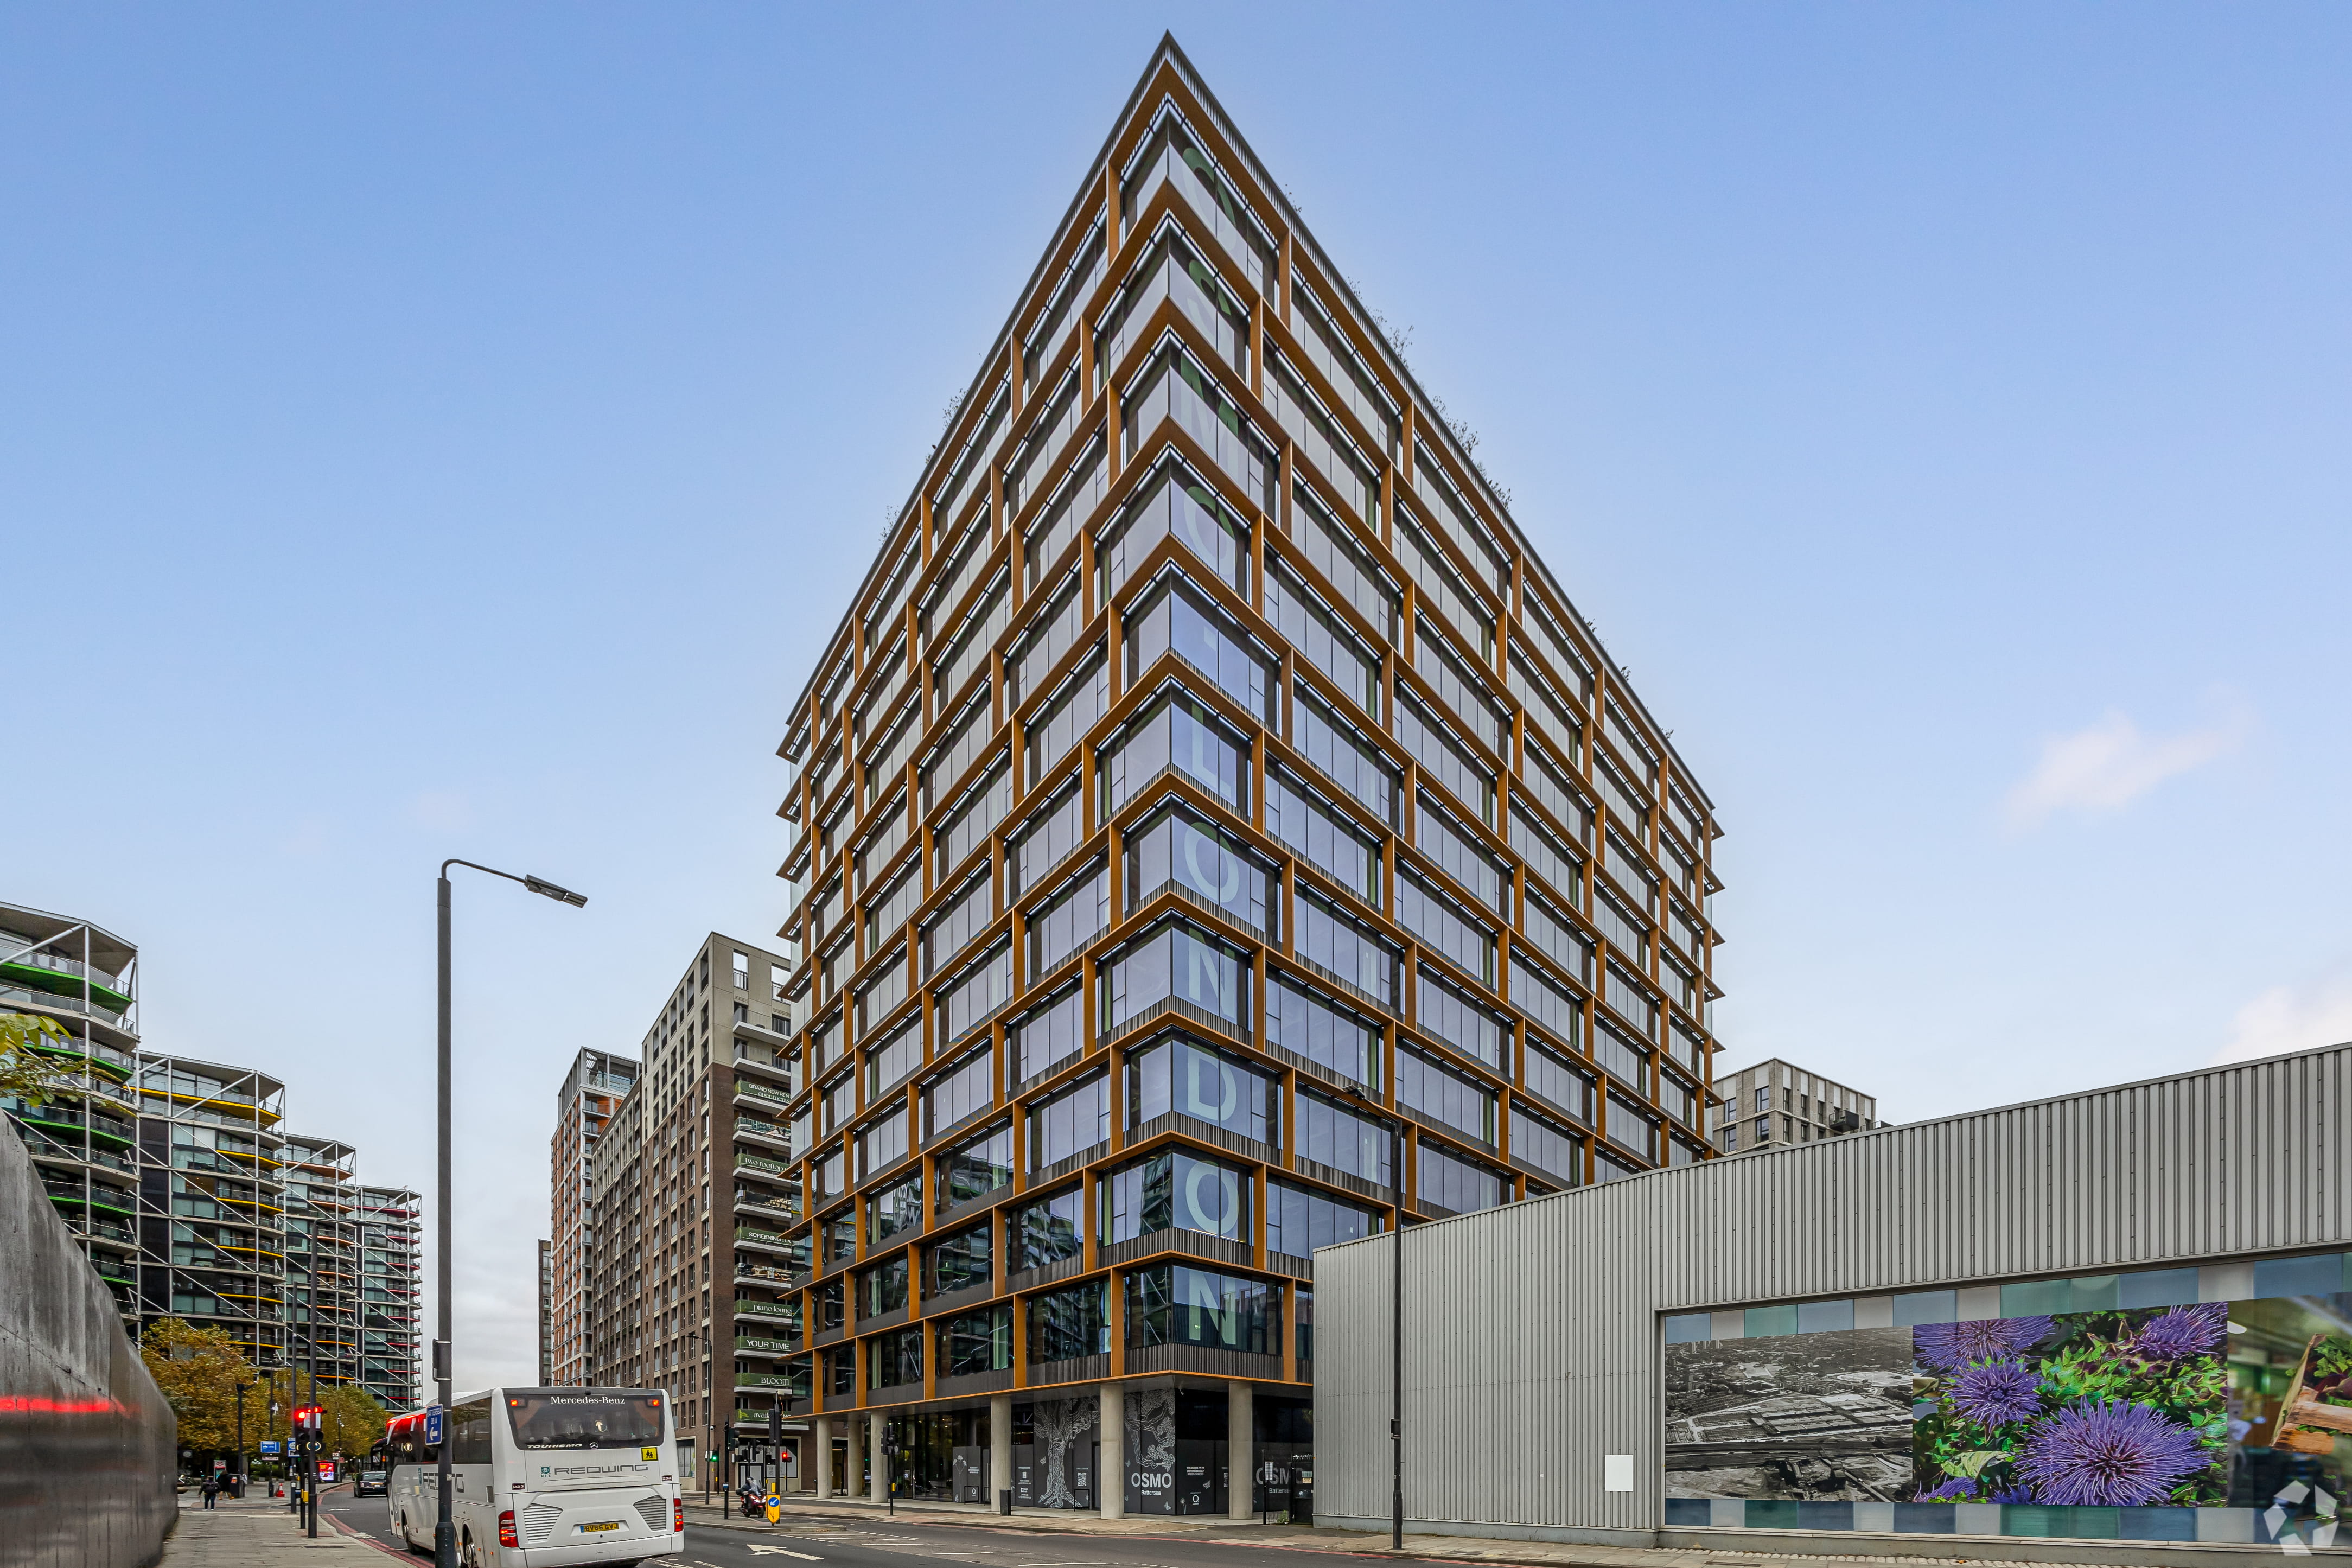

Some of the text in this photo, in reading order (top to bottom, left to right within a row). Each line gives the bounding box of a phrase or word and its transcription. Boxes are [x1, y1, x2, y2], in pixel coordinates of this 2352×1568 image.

[749, 1083, 767, 1092] BRAND
[760, 1162, 783, 1171] rooftop
[748, 1232, 782, 1241] SCREENING
[747, 1340, 790, 1350] YOUR TIME
[761, 1377, 789, 1385] BLOOM
[550, 1396, 625, 1404] Mercedes-Benz
[554, 1464, 648, 1475] REDWING
[1131, 1473, 1172, 1488] OSMO
